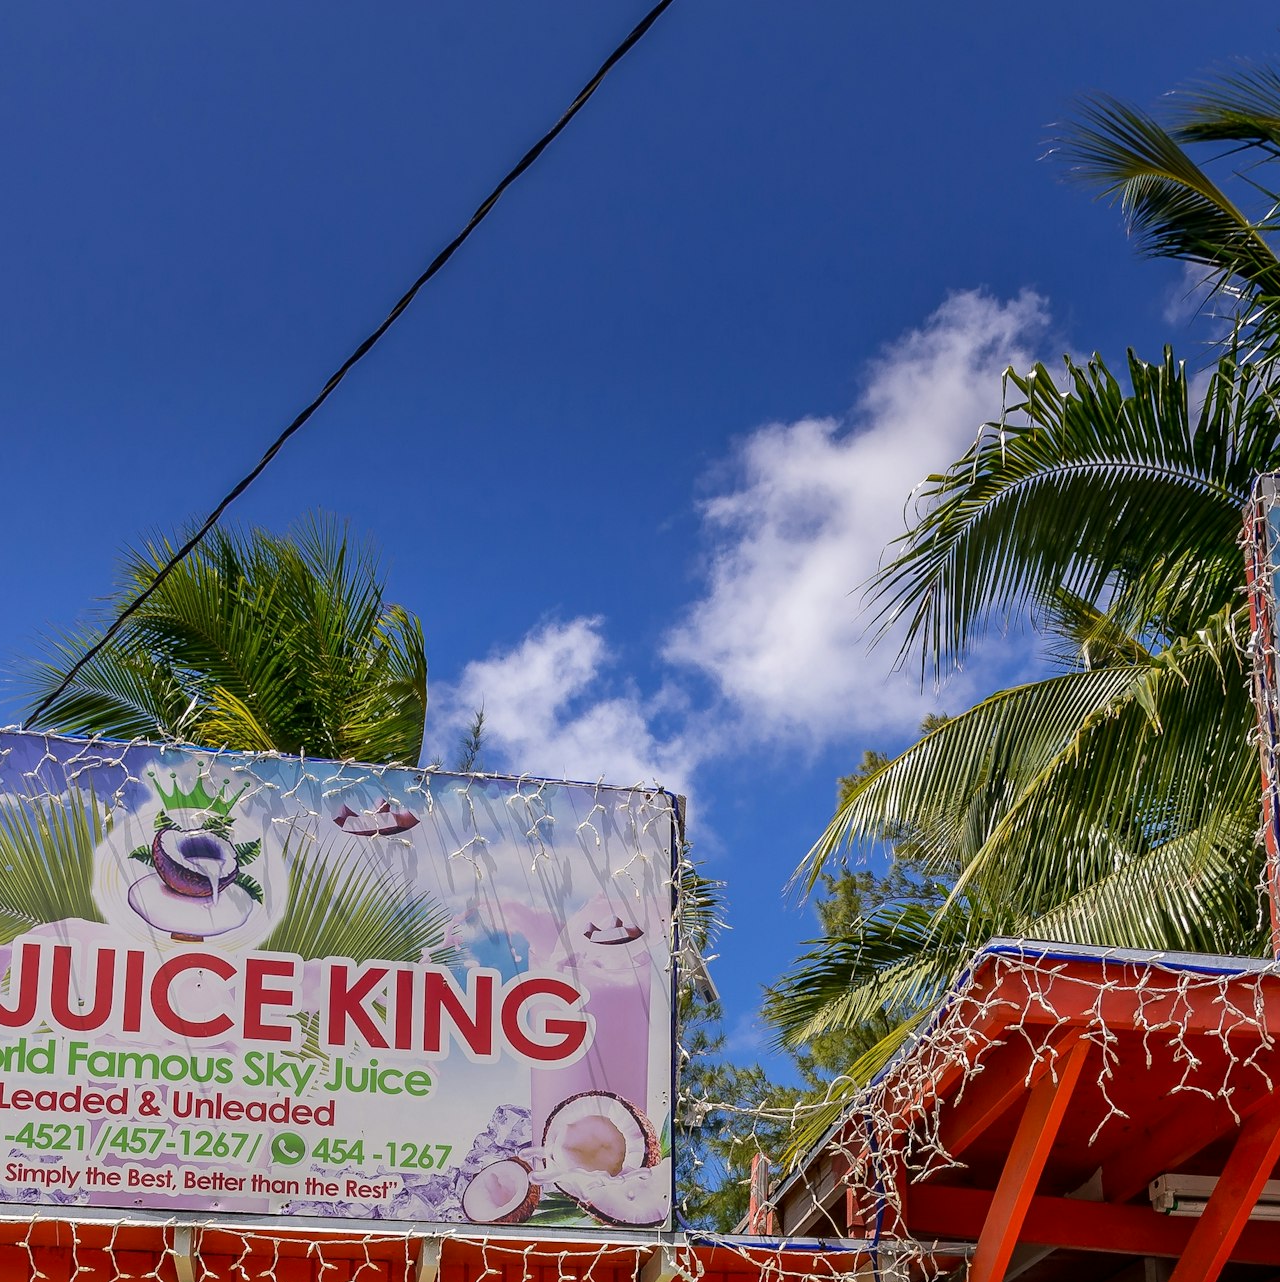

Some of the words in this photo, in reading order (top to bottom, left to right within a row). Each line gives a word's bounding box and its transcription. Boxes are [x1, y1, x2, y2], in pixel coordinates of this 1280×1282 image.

[327, 964, 589, 1061] KING
[68, 1041, 233, 1085] Famous
[242, 1051, 316, 1097] Sky
[324, 1058, 432, 1096] Juice
[138, 1091, 162, 1116] &
[173, 1091, 335, 1126] Unleaded
[5, 1163, 80, 1188] Simply
[85, 1167, 121, 1186] the
[128, 1169, 177, 1190] Best,
[184, 1171, 246, 1192] Better
[251, 1175, 299, 1194] than
[305, 1177, 339, 1196] the
